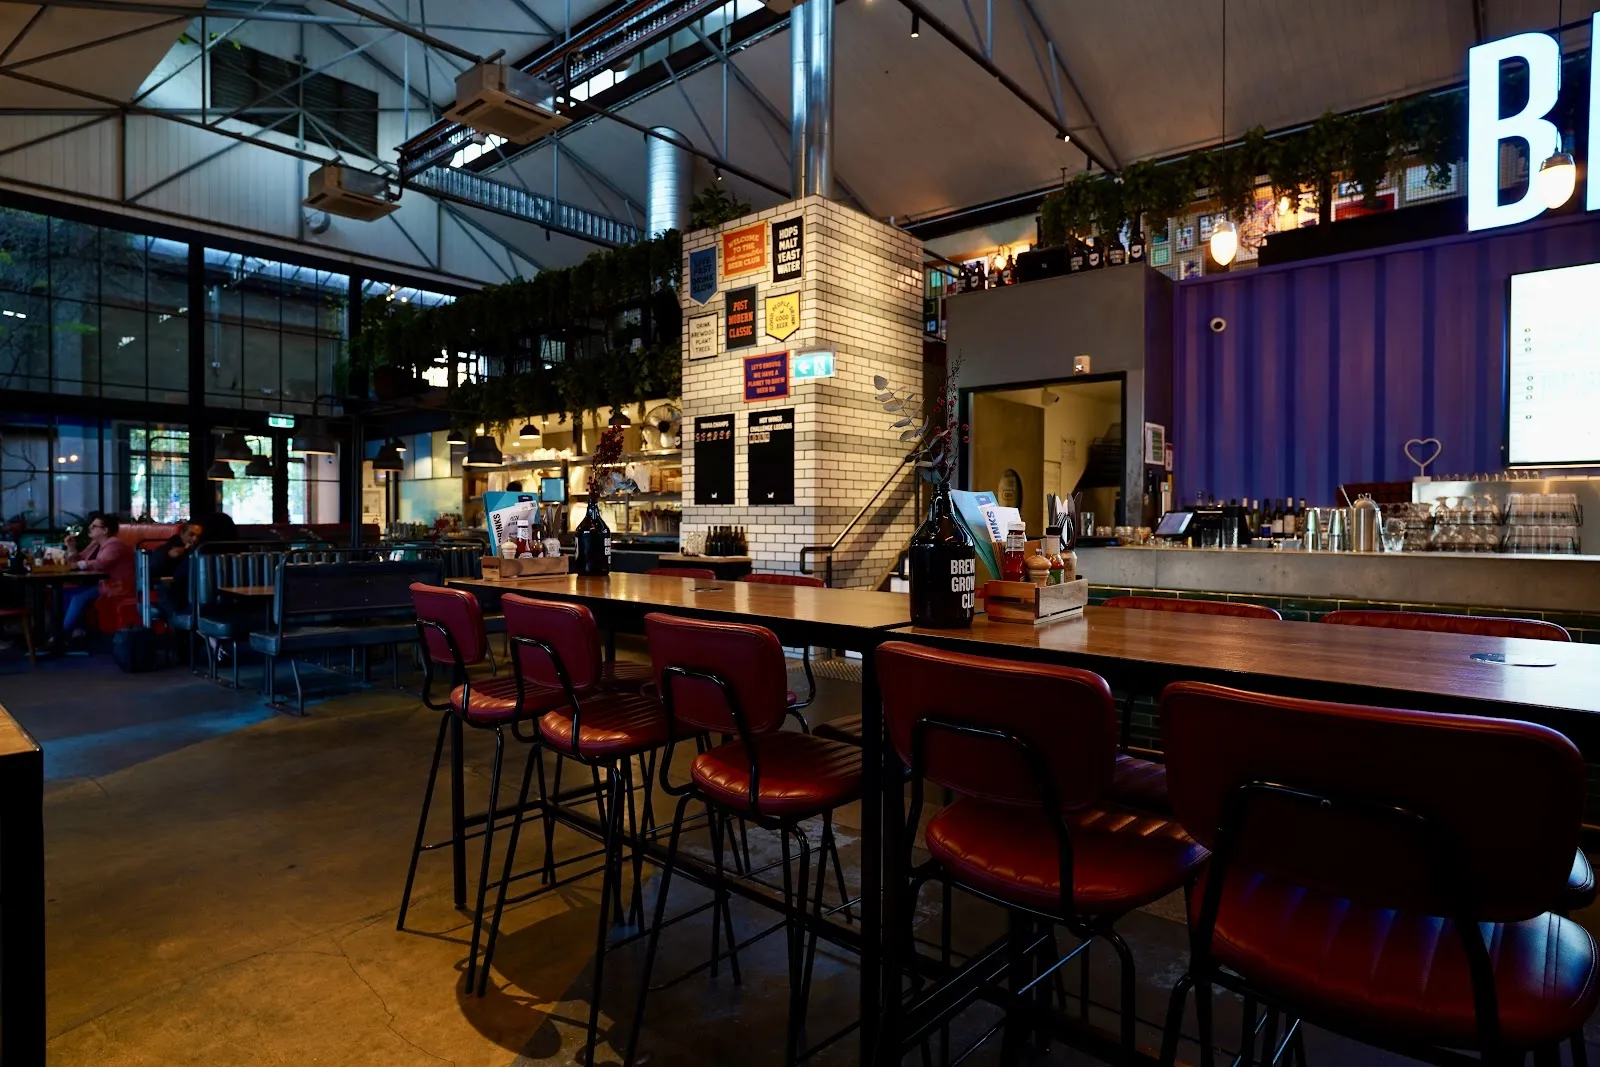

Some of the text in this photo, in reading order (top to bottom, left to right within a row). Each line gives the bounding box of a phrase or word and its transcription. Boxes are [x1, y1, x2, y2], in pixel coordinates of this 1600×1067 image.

[1468, 11, 1600, 232] B
[779, 225, 798, 240] HOPS
[728, 235, 759, 248] WELCOME
[779, 237, 798, 251] MALT
[733, 242, 755, 254] TO THE
[778, 248, 801, 263] YEAST
[728, 260, 743, 270] BEER
[743, 255, 760, 266] CLUB
[777, 260, 801, 275] WATER
[692, 281, 714, 293] SLOW
[733, 299, 748, 311] POST
[772, 301, 790, 312] PEOPLE
[728, 311, 753, 325] MODERN
[775, 314, 789, 322] GOOD
[696, 321, 711, 329] DRINK
[776, 321, 788, 329] BEER
[729, 325, 753, 338] CLASSIC
[695, 337, 711, 345] PLANT
[747, 379, 764, 387] PLANET
[713, 420, 729, 428] CHAMPS
[759, 416, 768, 424] HOT
[749, 422, 793, 433] CHALLENGE LEGENDS
